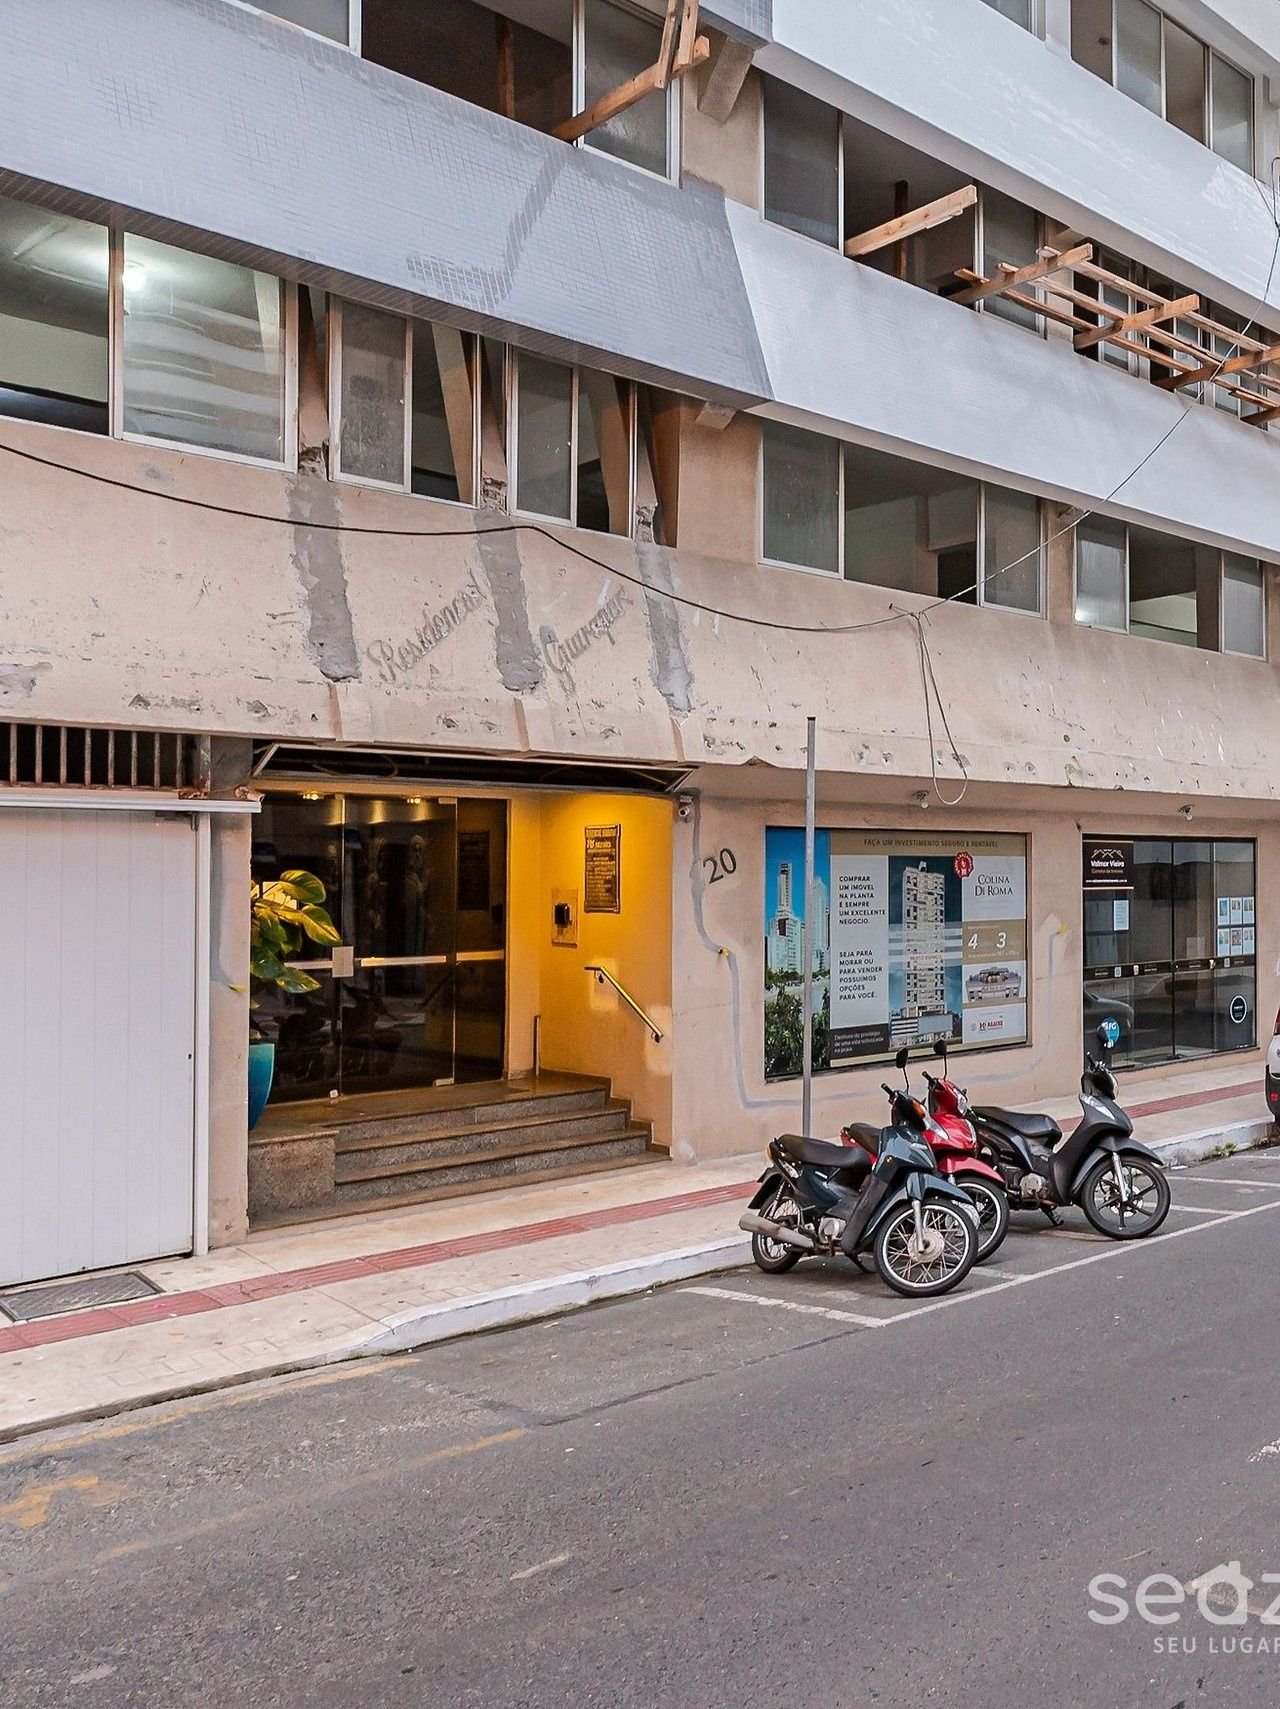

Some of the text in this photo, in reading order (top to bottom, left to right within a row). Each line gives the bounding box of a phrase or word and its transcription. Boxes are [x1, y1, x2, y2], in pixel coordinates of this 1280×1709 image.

[703, 848, 737, 884] 20
[978, 874, 1010, 885] COLINA
[988, 885, 1013, 896] ROMA
[968, 933, 978, 949] 4
[996, 932, 1007, 948] 3
[857, 966, 883, 974] VENDER
[839, 993, 856, 1001] PARA
